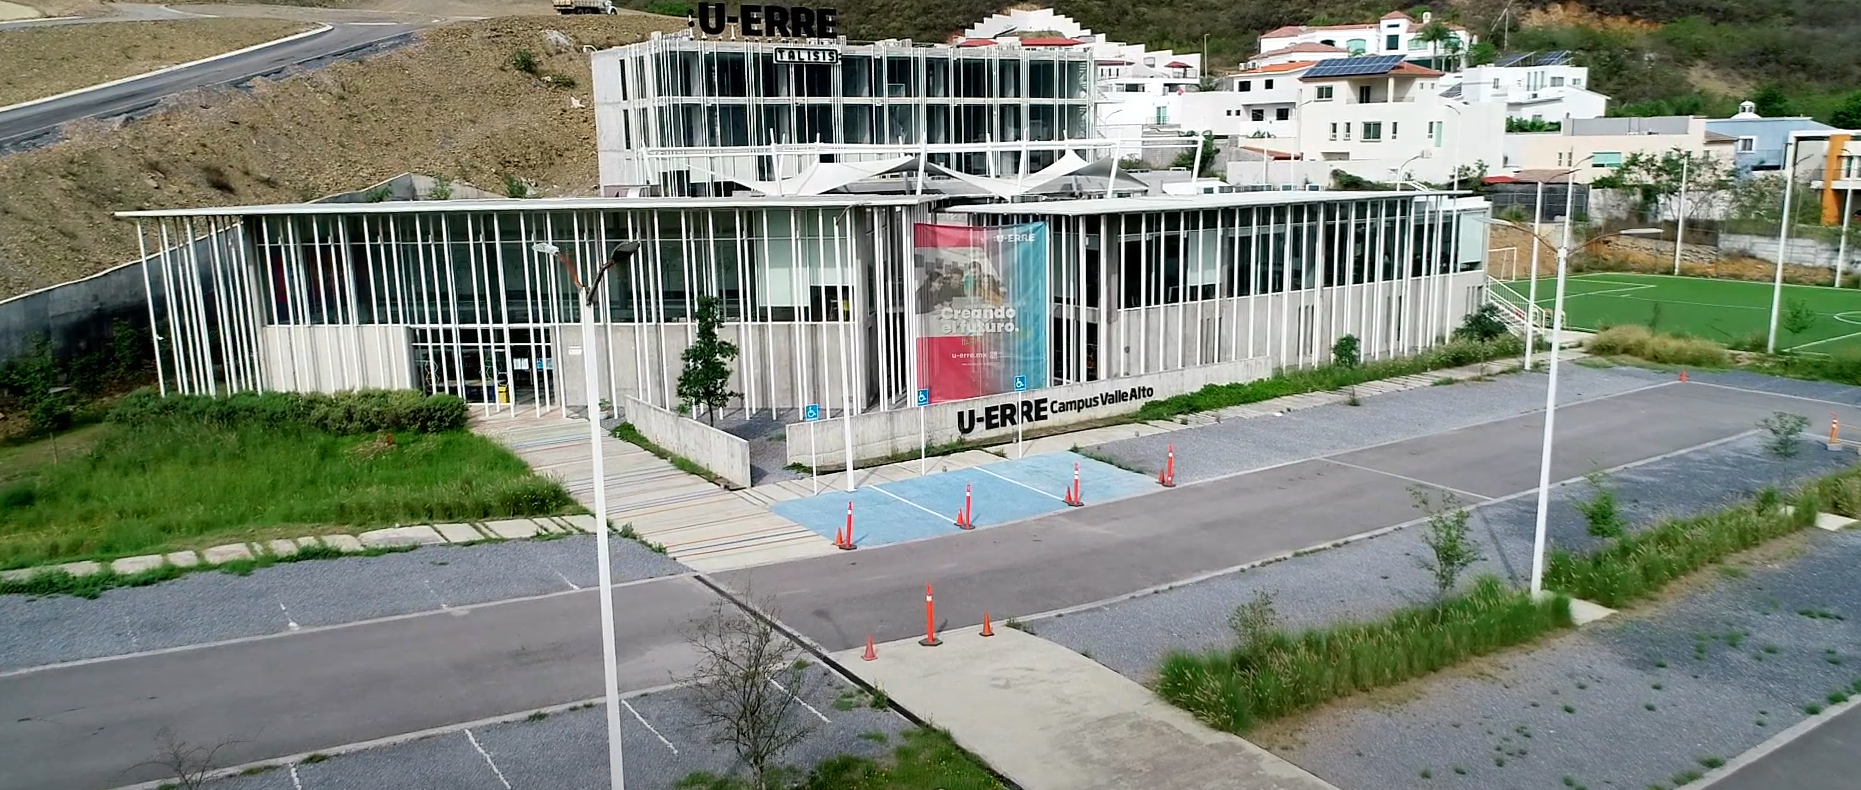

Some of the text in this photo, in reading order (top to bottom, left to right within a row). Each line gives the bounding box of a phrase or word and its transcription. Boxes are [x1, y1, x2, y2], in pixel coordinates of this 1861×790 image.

[941, 305, 1016, 320] Creando
[957, 385, 1154, 434] U-ERRE Campus Valle Alto
